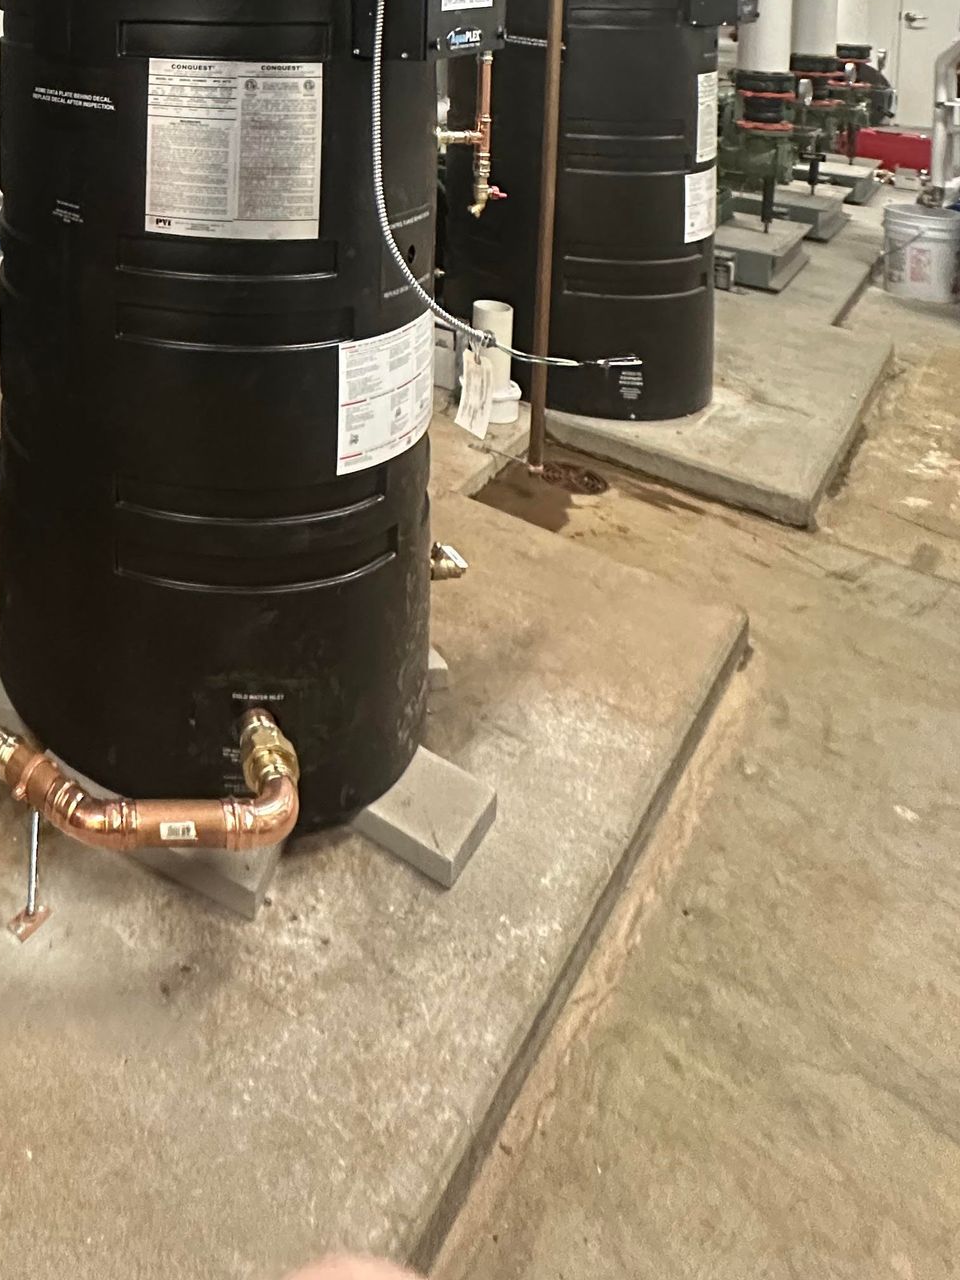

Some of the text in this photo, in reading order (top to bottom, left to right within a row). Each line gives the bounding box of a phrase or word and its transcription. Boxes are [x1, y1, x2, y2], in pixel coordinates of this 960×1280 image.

[171, 63, 213, 71] CONQUEST
[260, 64, 302, 72] CONQUEST
[32, 92, 51, 101] REPLACE
[51, 96, 67, 104] DECAL
[66, 98, 83, 106] AFTER
[46, 88, 59, 96] DATA
[58, 90, 73, 98] PLATE
[73, 92, 93, 101] BEHIND
[155, 217, 172, 227] PVI
